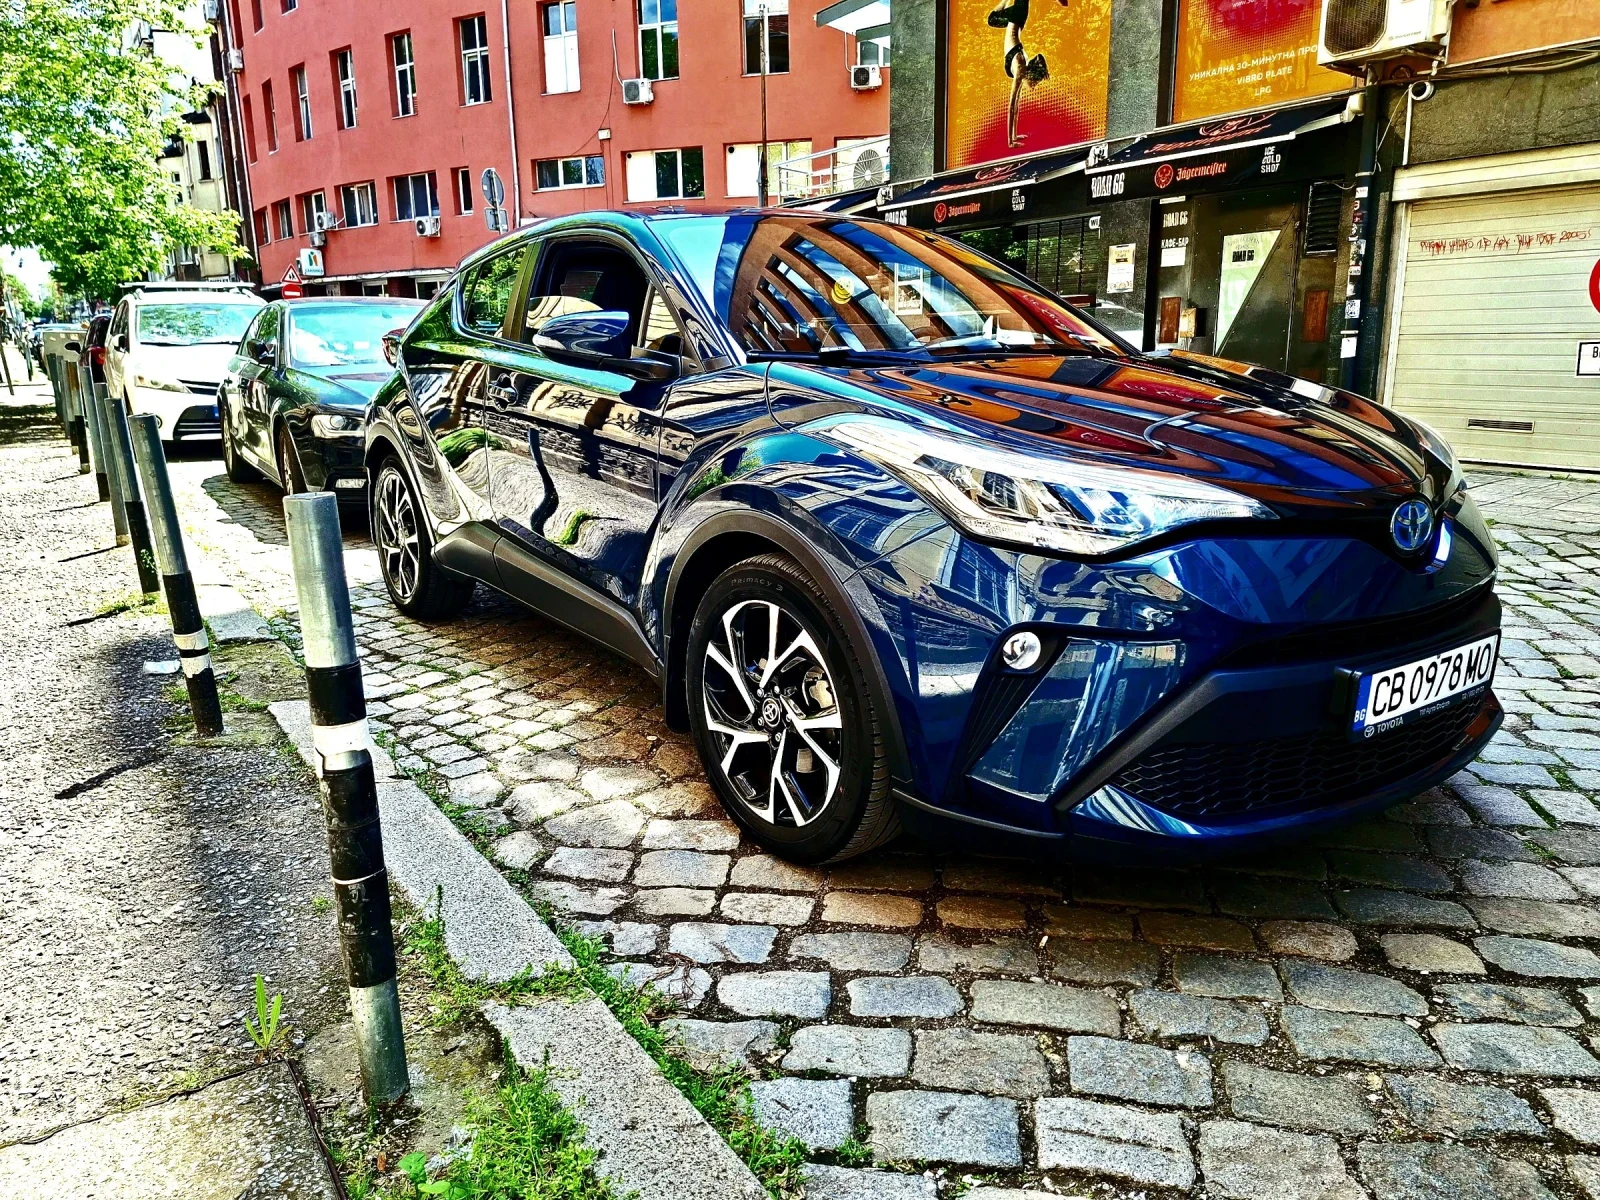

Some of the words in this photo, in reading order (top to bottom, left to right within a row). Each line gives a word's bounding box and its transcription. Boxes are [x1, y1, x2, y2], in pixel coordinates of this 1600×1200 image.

[1189, 65, 1235, 82] УНИКАЛНА
[1236, 49, 1295, 71] 30-МИНУТНА
[1297, 44, 1318, 57] ПРО
[1237, 72, 1263, 85] VIBRO
[1266, 66, 1293, 79] PLATE
[1254, 86, 1272, 96] LPG
[1264, 146, 1276, 156] ICE
[1262, 154, 1281, 165] COLD
[1260, 163, 1280, 174] SHOT
[1091, 174, 1113, 198] ROAD
[1112, 172, 1125, 196] 66
[1011, 195, 1026, 204] COLD
[1162, 212, 1179, 228] ROAD
[1179, 210, 1188, 226] 66
[1160, 237, 1189, 249] КАФЕ-БАР
[775, 583, 784, 592] 3
[1372, 671, 1406, 717] CB
[1409, 653, 1463, 705] 0978
[1463, 643, 1492, 687] MO
[1354, 708, 1366, 723] BG
[1376, 716, 1404, 734] TOYOTA
